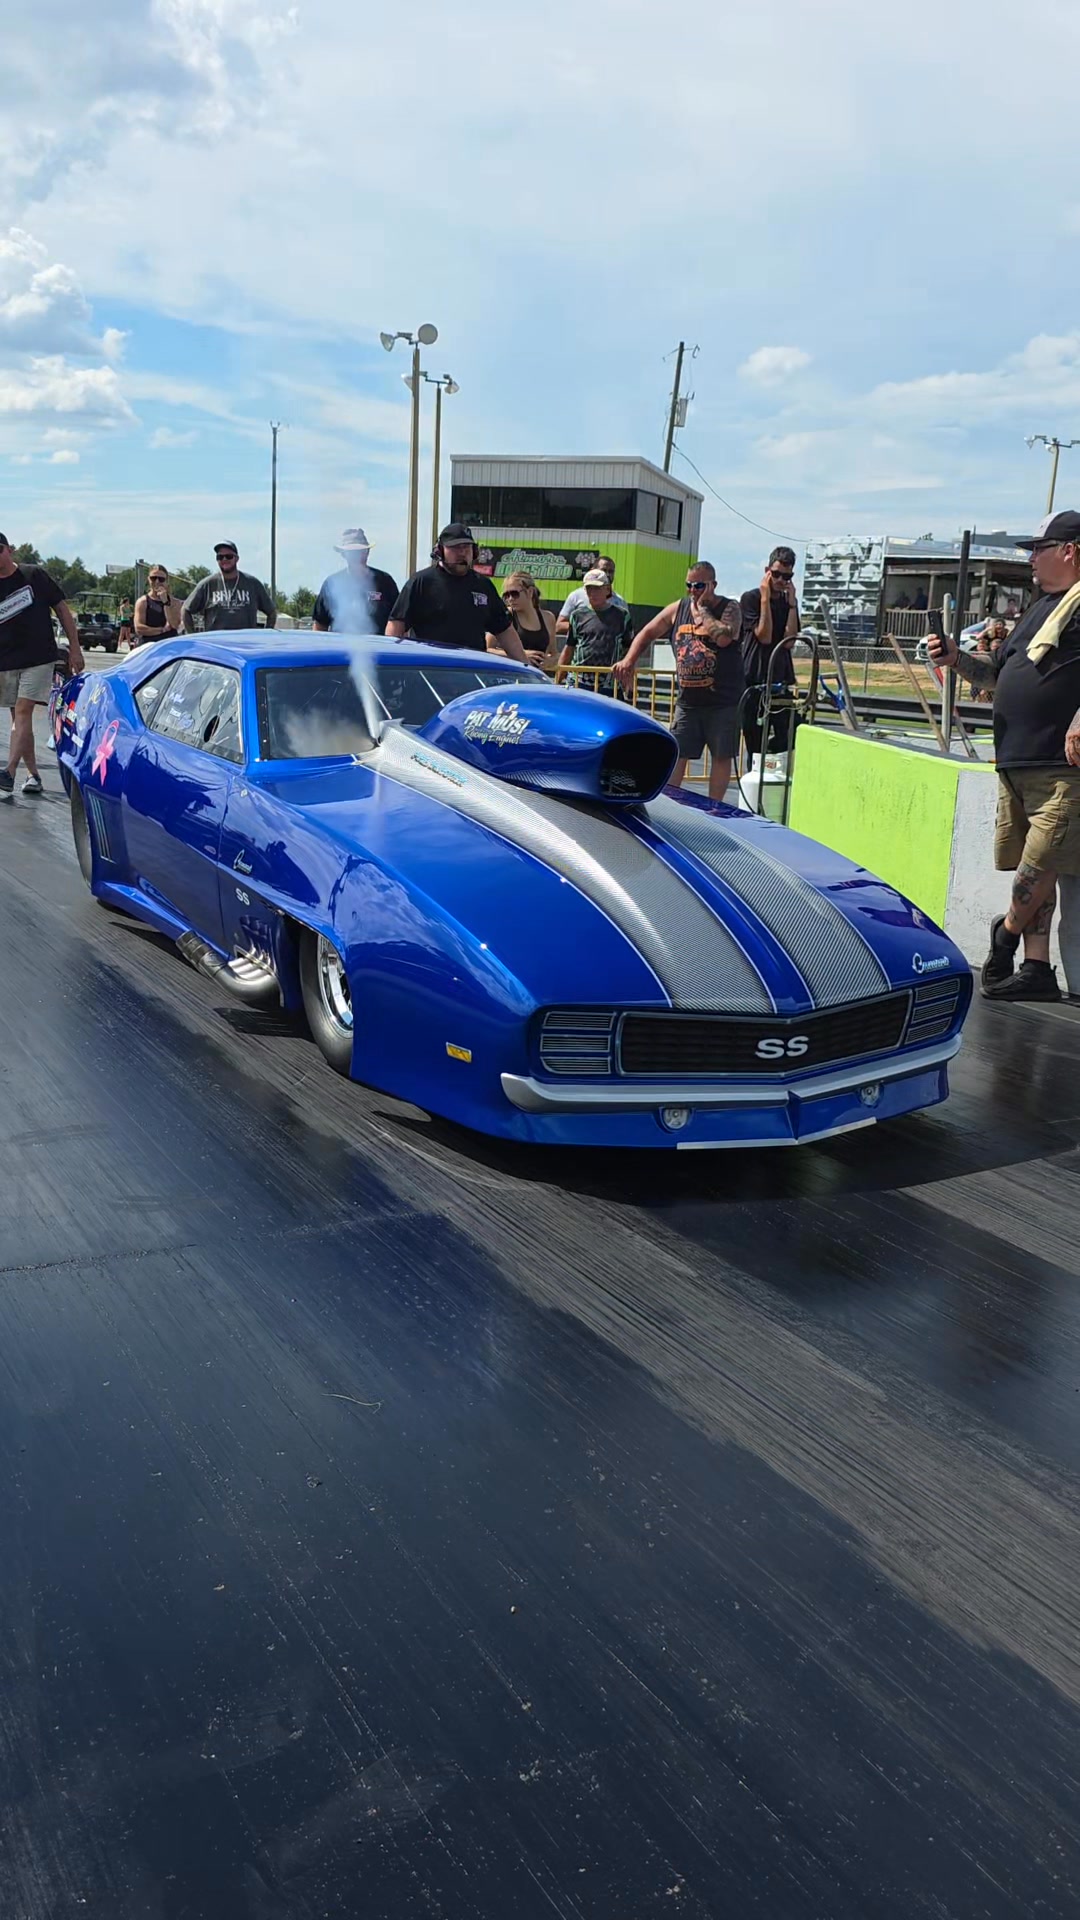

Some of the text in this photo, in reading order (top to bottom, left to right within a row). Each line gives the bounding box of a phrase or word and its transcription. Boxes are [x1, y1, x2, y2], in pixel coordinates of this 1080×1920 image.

[464, 710, 531, 735] PAT MUSI
[464, 725, 520, 747] Racing Engines
[235, 887, 250, 906] SS
[755, 1035, 809, 1059] SS
